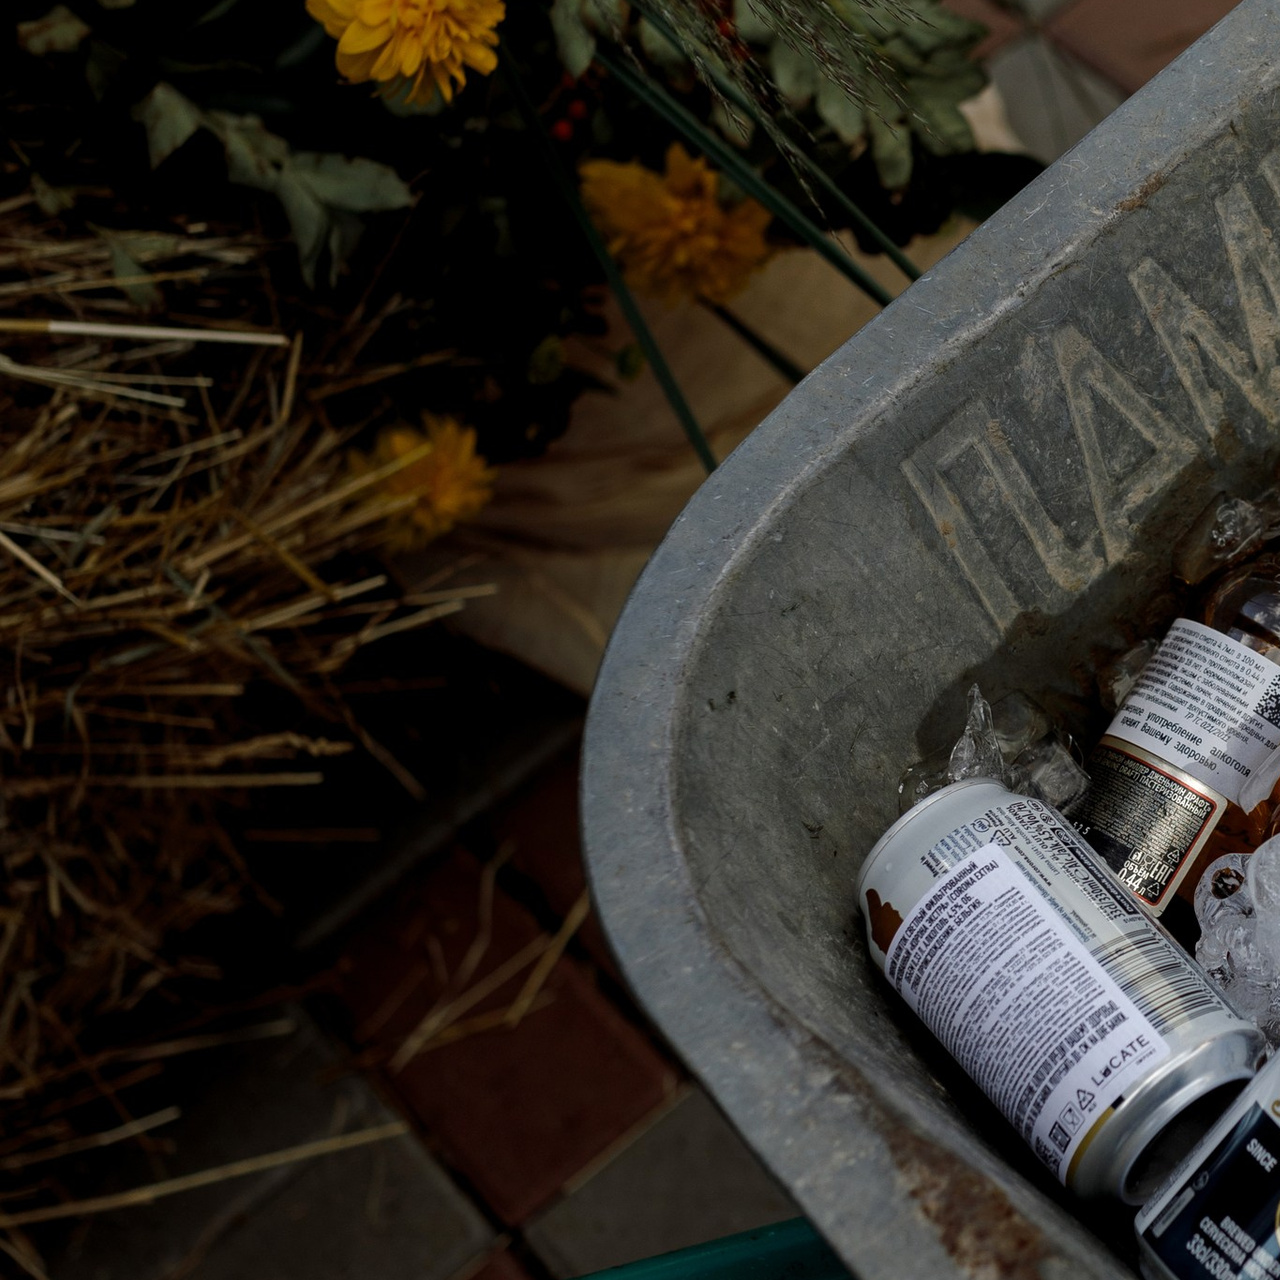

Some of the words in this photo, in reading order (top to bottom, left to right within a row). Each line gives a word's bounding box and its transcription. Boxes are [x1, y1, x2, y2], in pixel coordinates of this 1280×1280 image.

[1139, 721, 1173, 745] Вашему
[1145, 710, 1203, 747] употребление
[1011, 799, 1040, 828] Vol./til
[1049, 838, 1081, 871] Alc./alk.
[1084, 875, 1125, 920] 33cl/330ml
[1245, 1136, 1277, 1173] SINCE
[1219, 1214, 1257, 1253] BREWED
